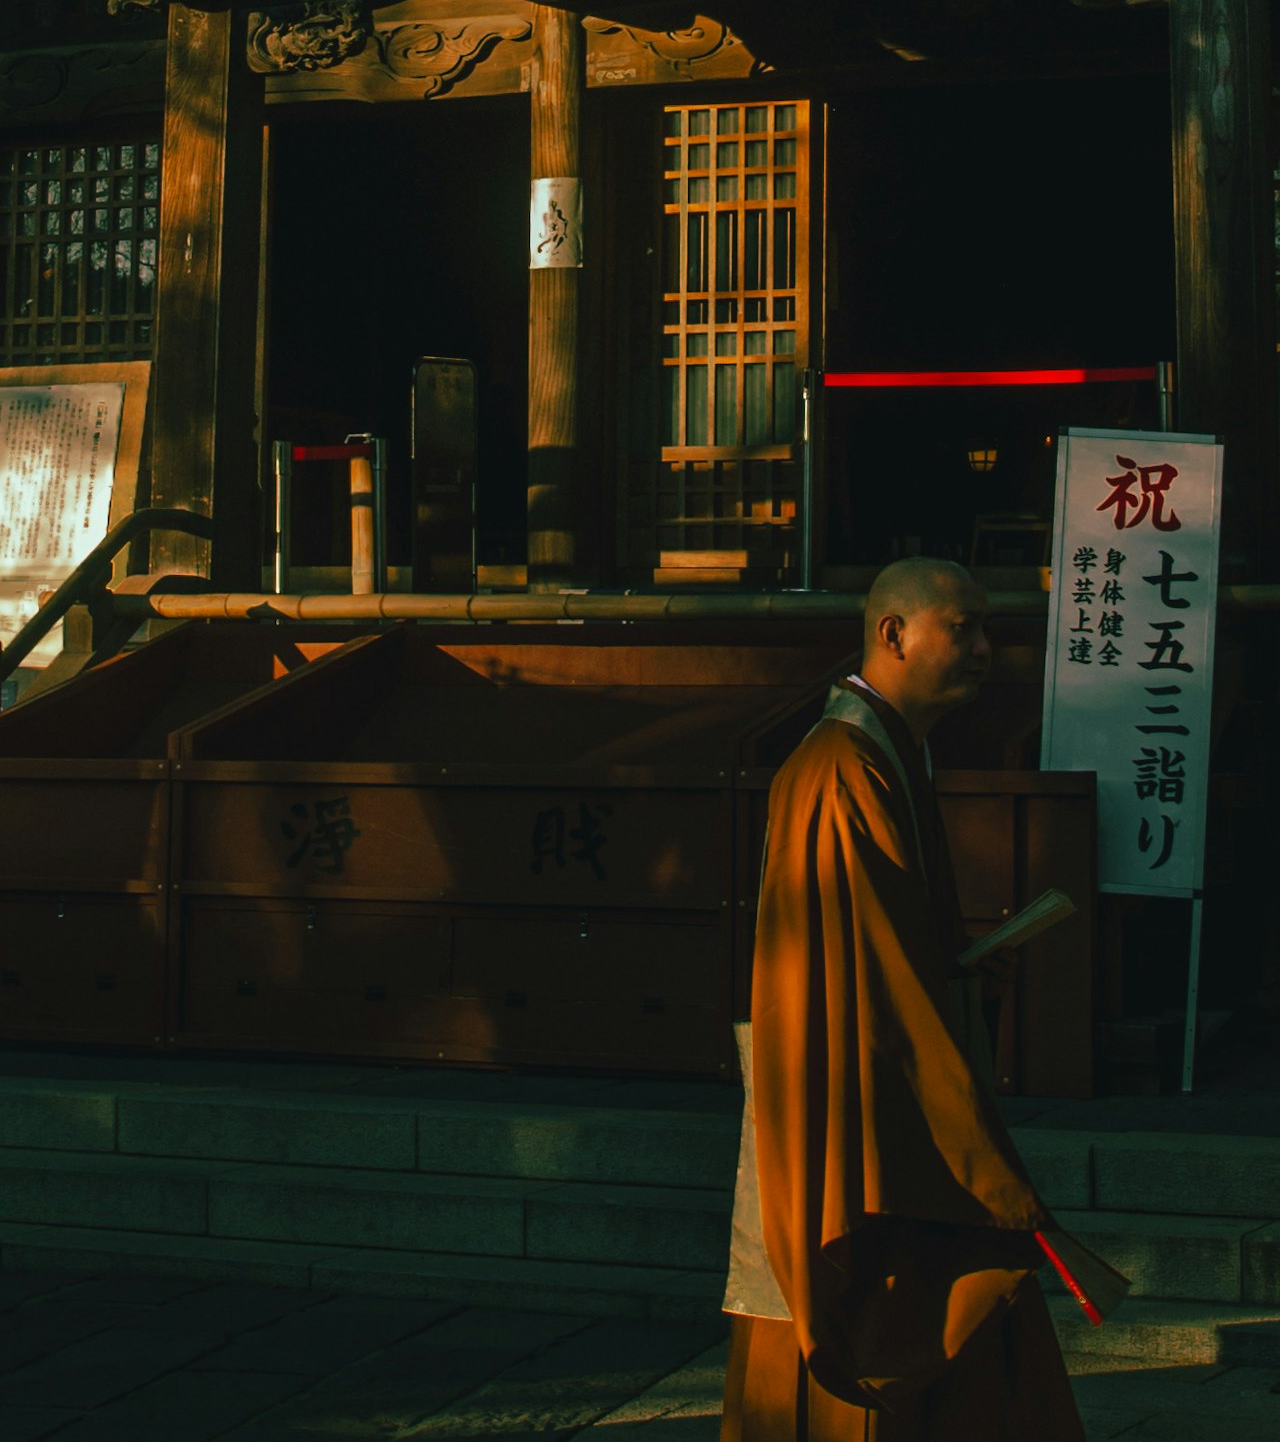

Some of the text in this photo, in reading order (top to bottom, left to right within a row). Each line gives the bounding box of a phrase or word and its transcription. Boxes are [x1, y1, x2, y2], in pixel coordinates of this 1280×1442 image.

[1095, 454, 1181, 532] 祝
[1068, 547, 1098, 666] 学芸上達
[1098, 547, 1125, 668] 身体健全
[1132, 549, 1199, 871] 七五三詣り
